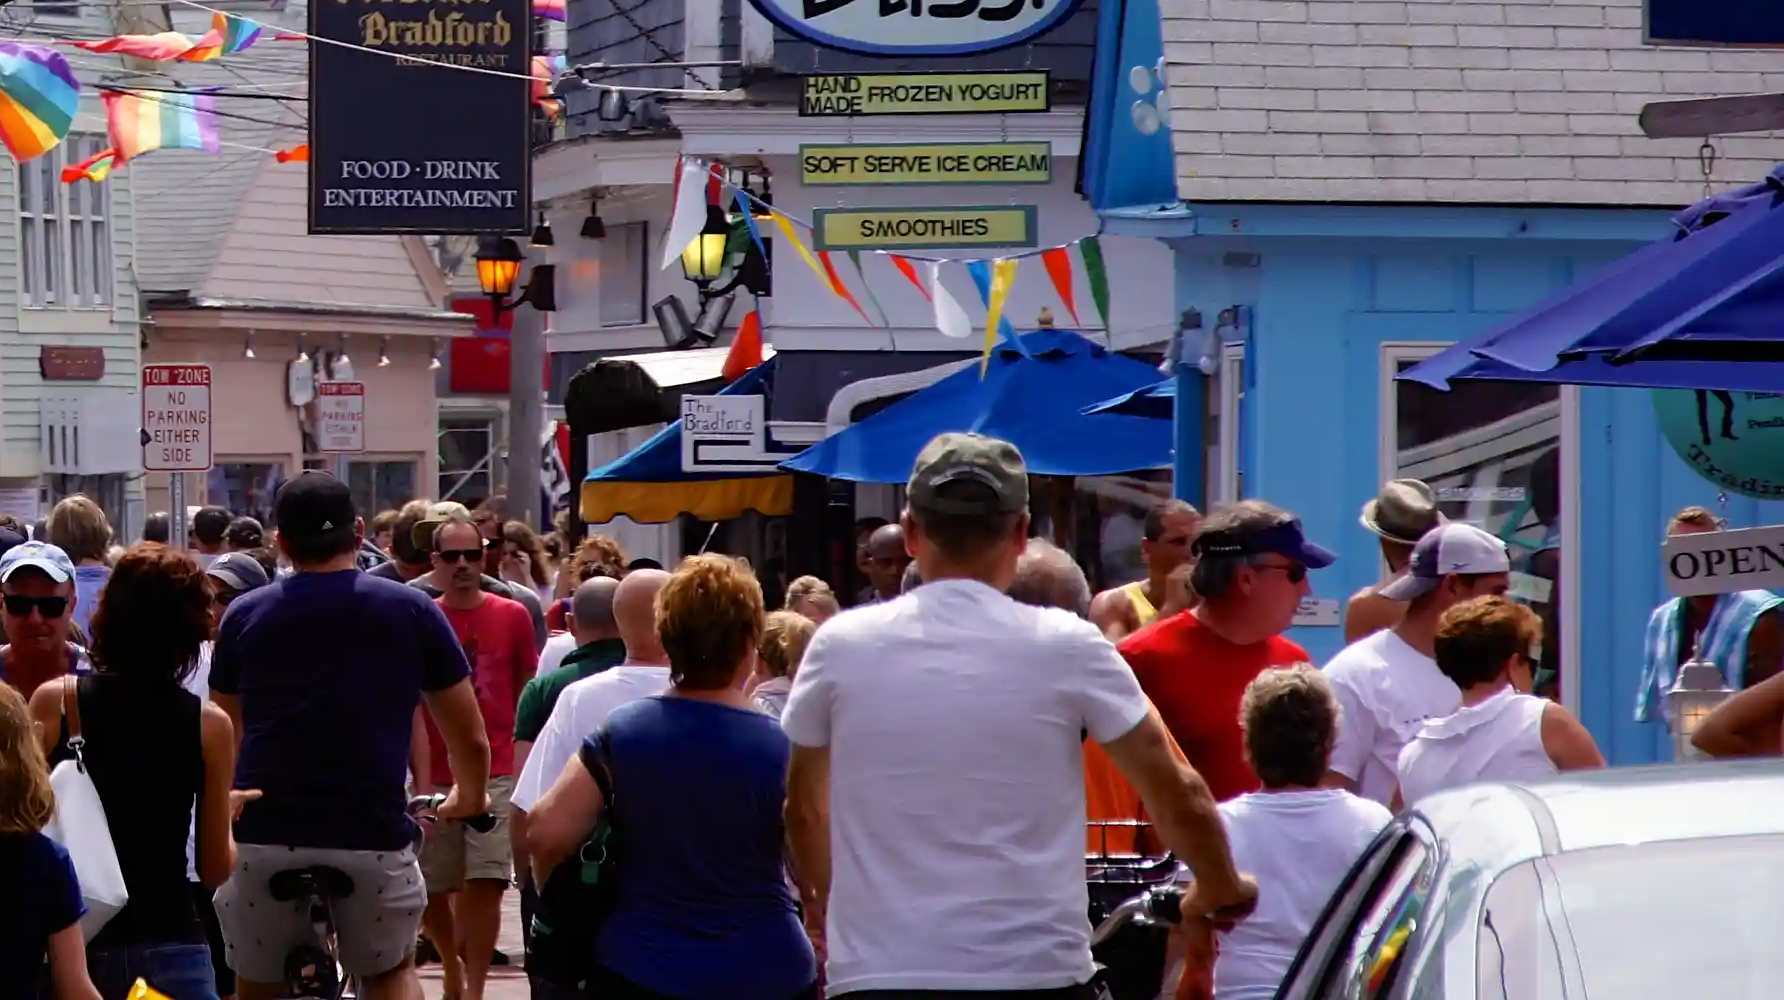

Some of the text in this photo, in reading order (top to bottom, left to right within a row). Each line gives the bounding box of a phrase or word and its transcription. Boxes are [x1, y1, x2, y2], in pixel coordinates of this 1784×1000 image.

[358, 9, 512, 48] Bradford
[396, 53, 509, 68] RESTAURANT
[805, 75, 861, 94] HAND
[867, 82, 1042, 104] FROZEN YOGURT
[806, 96, 863, 113] MADE
[341, 161, 501, 180] FOOD DRINK
[804, 154, 1048, 174] SOFT SERVE ICE CREAM
[323, 189, 518, 207] ENTERTAINMENT
[860, 218, 989, 238] SMOOTHIES
[176, 368, 210, 384] ZONE
[168, 391, 186, 405] NO
[684, 399, 714, 413] The
[148, 410, 207, 424] PARKING
[684, 410, 753, 431] Bradford
[154, 429, 200, 443] EITHER
[162, 448, 192, 463] SIDE
[1670, 544, 1784, 580] OPEN
